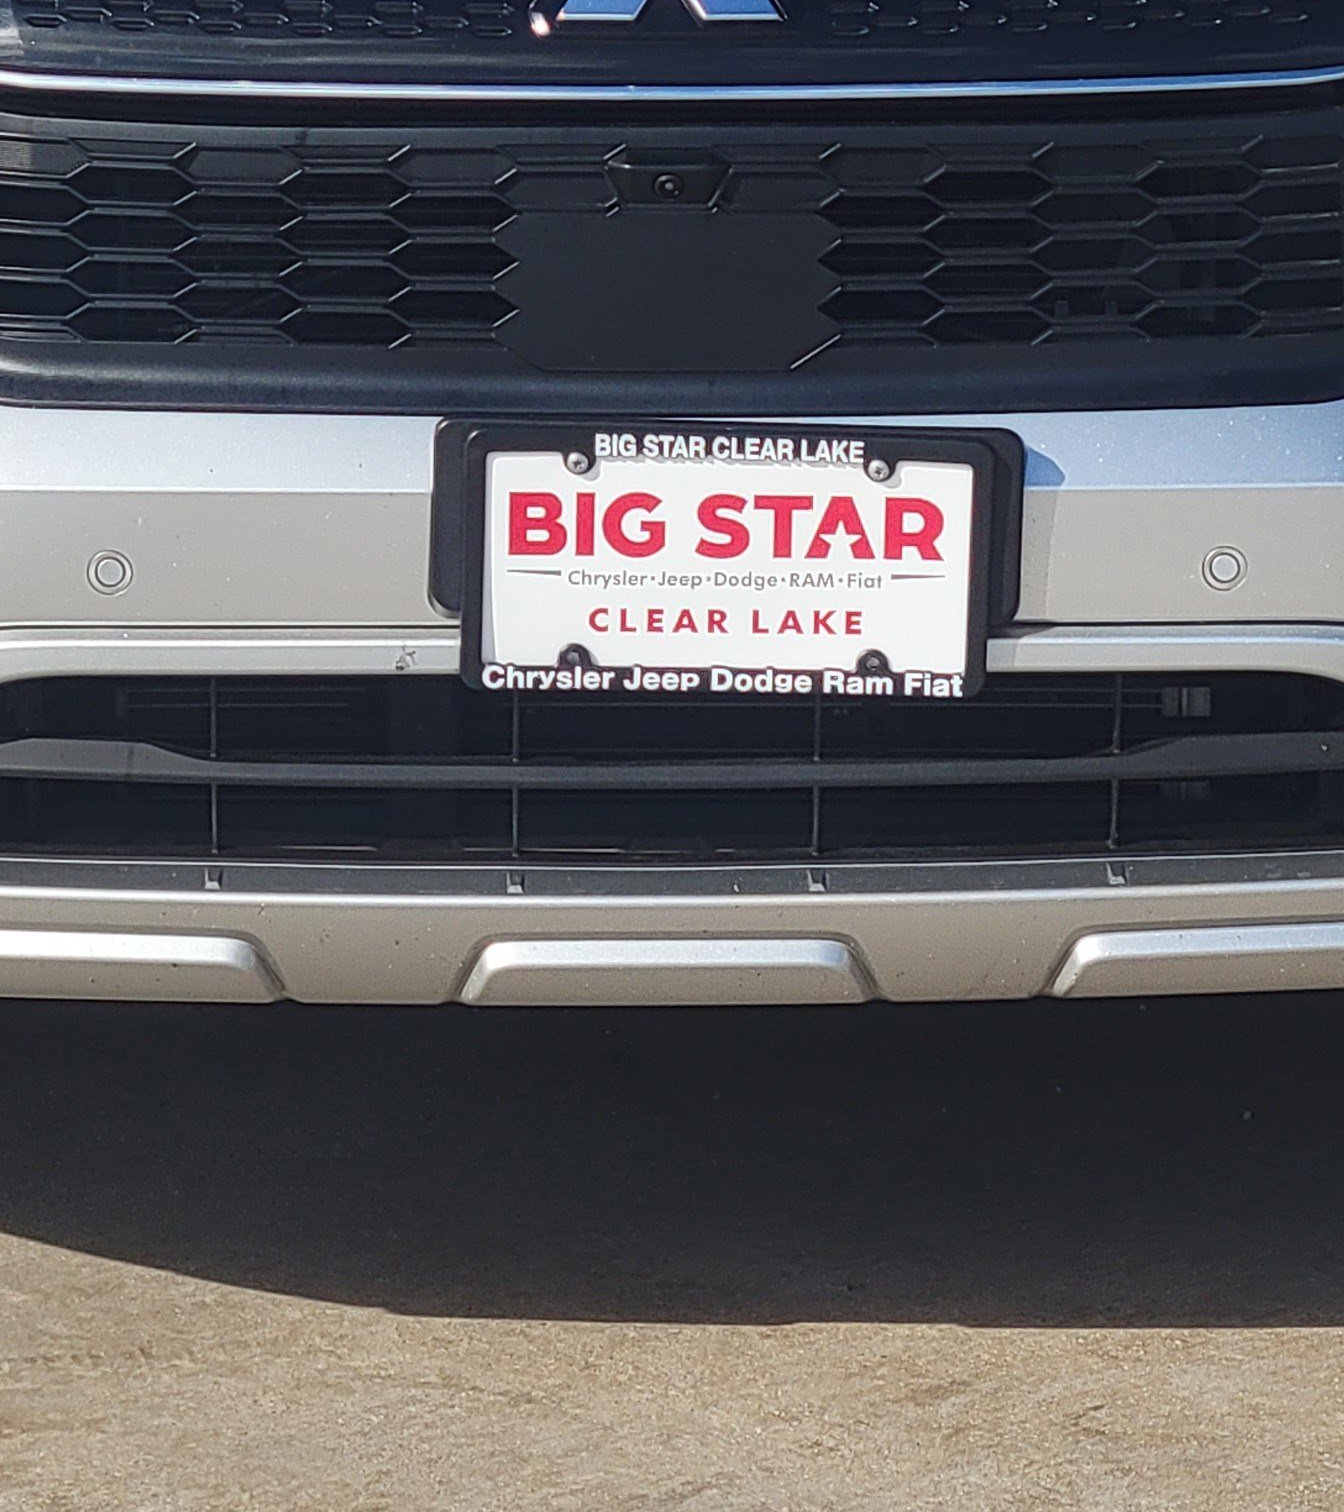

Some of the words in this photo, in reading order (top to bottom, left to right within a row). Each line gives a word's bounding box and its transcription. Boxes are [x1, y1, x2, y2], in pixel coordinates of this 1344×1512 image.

[595, 433, 637, 458] BIG
[643, 434, 706, 460] STAR
[712, 434, 794, 462] CLEAR
[799, 437, 864, 464] LAKE
[508, 491, 666, 559] BIG
[694, 493, 945, 562] STAR
[567, 570, 650, 590] Chrysler
[658, 571, 702, 590] Jeep
[714, 571, 778, 591] Dodge
[790, 572, 835, 589] RAM
[847, 573, 883, 590] Fiat
[588, 607, 730, 635] CLEAR
[752, 609, 863, 636] LAKE
[481, 665, 616, 693] Chrysler
[623, 666, 699, 694] Jeep
[709, 669, 812, 697] Dodge
[823, 671, 894, 696] Ram
[903, 672, 965, 698] Fiat
